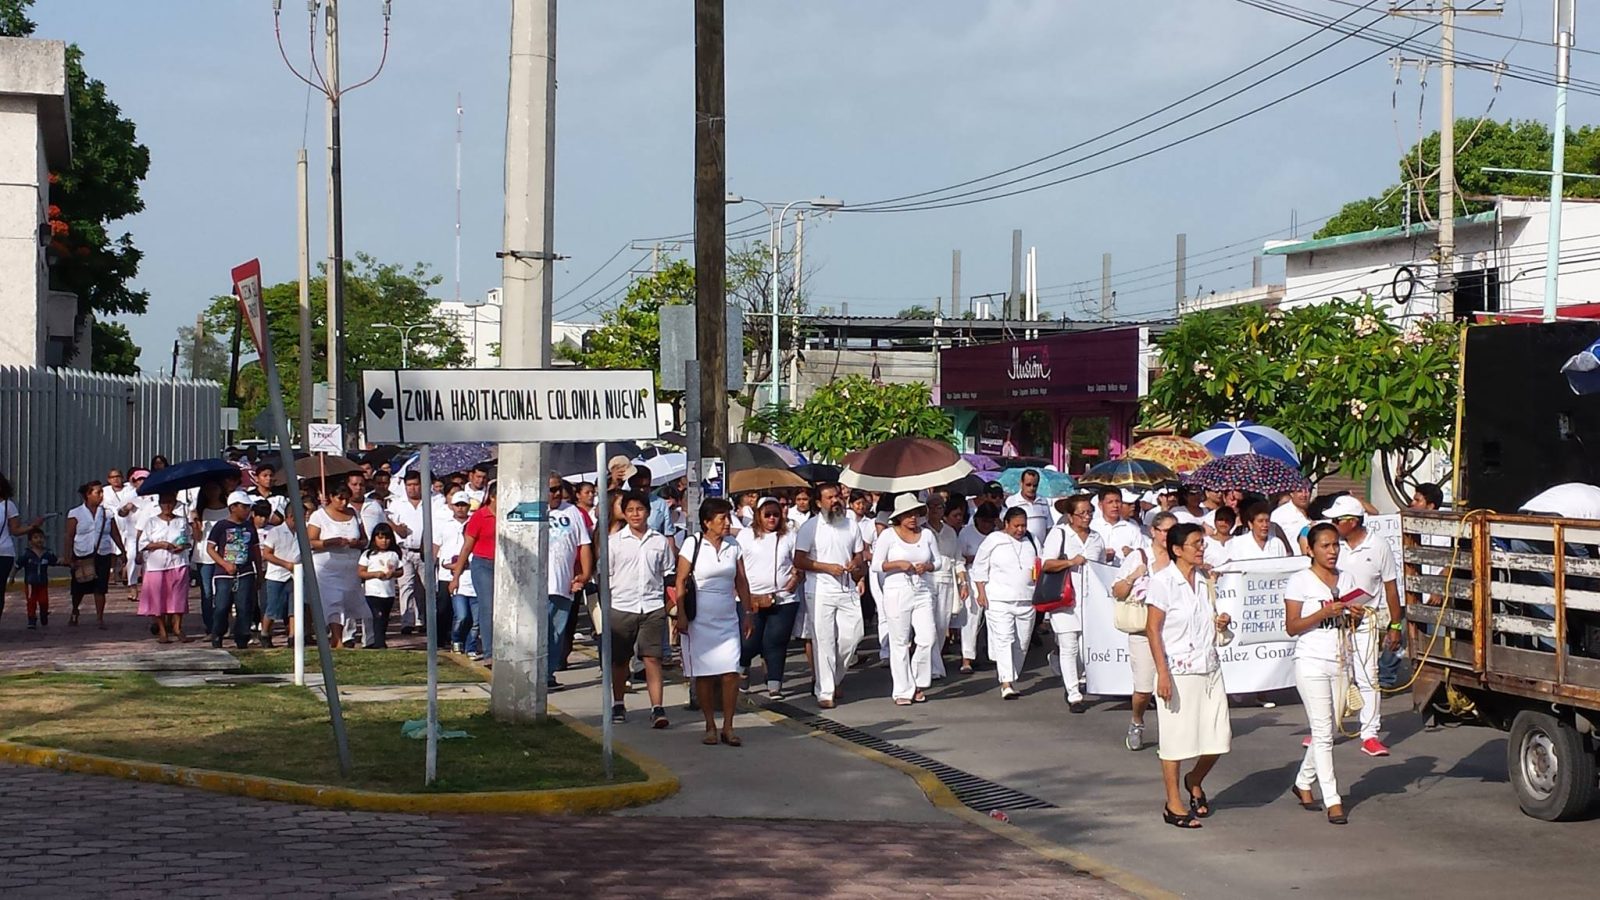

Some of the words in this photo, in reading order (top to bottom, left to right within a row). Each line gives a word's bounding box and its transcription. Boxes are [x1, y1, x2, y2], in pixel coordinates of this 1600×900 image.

[402, 389, 444, 421] ZONA
[451, 389, 542, 421] HABITACIONAL
[548, 389, 601, 420] COLONIA
[605, 389, 647, 420] NUEVA
[1242, 610, 1260, 620] QUE
[1086, 647, 1111, 665] José
[1116, 648, 1130, 662] Fr
[1219, 647, 1249, 663] ález
